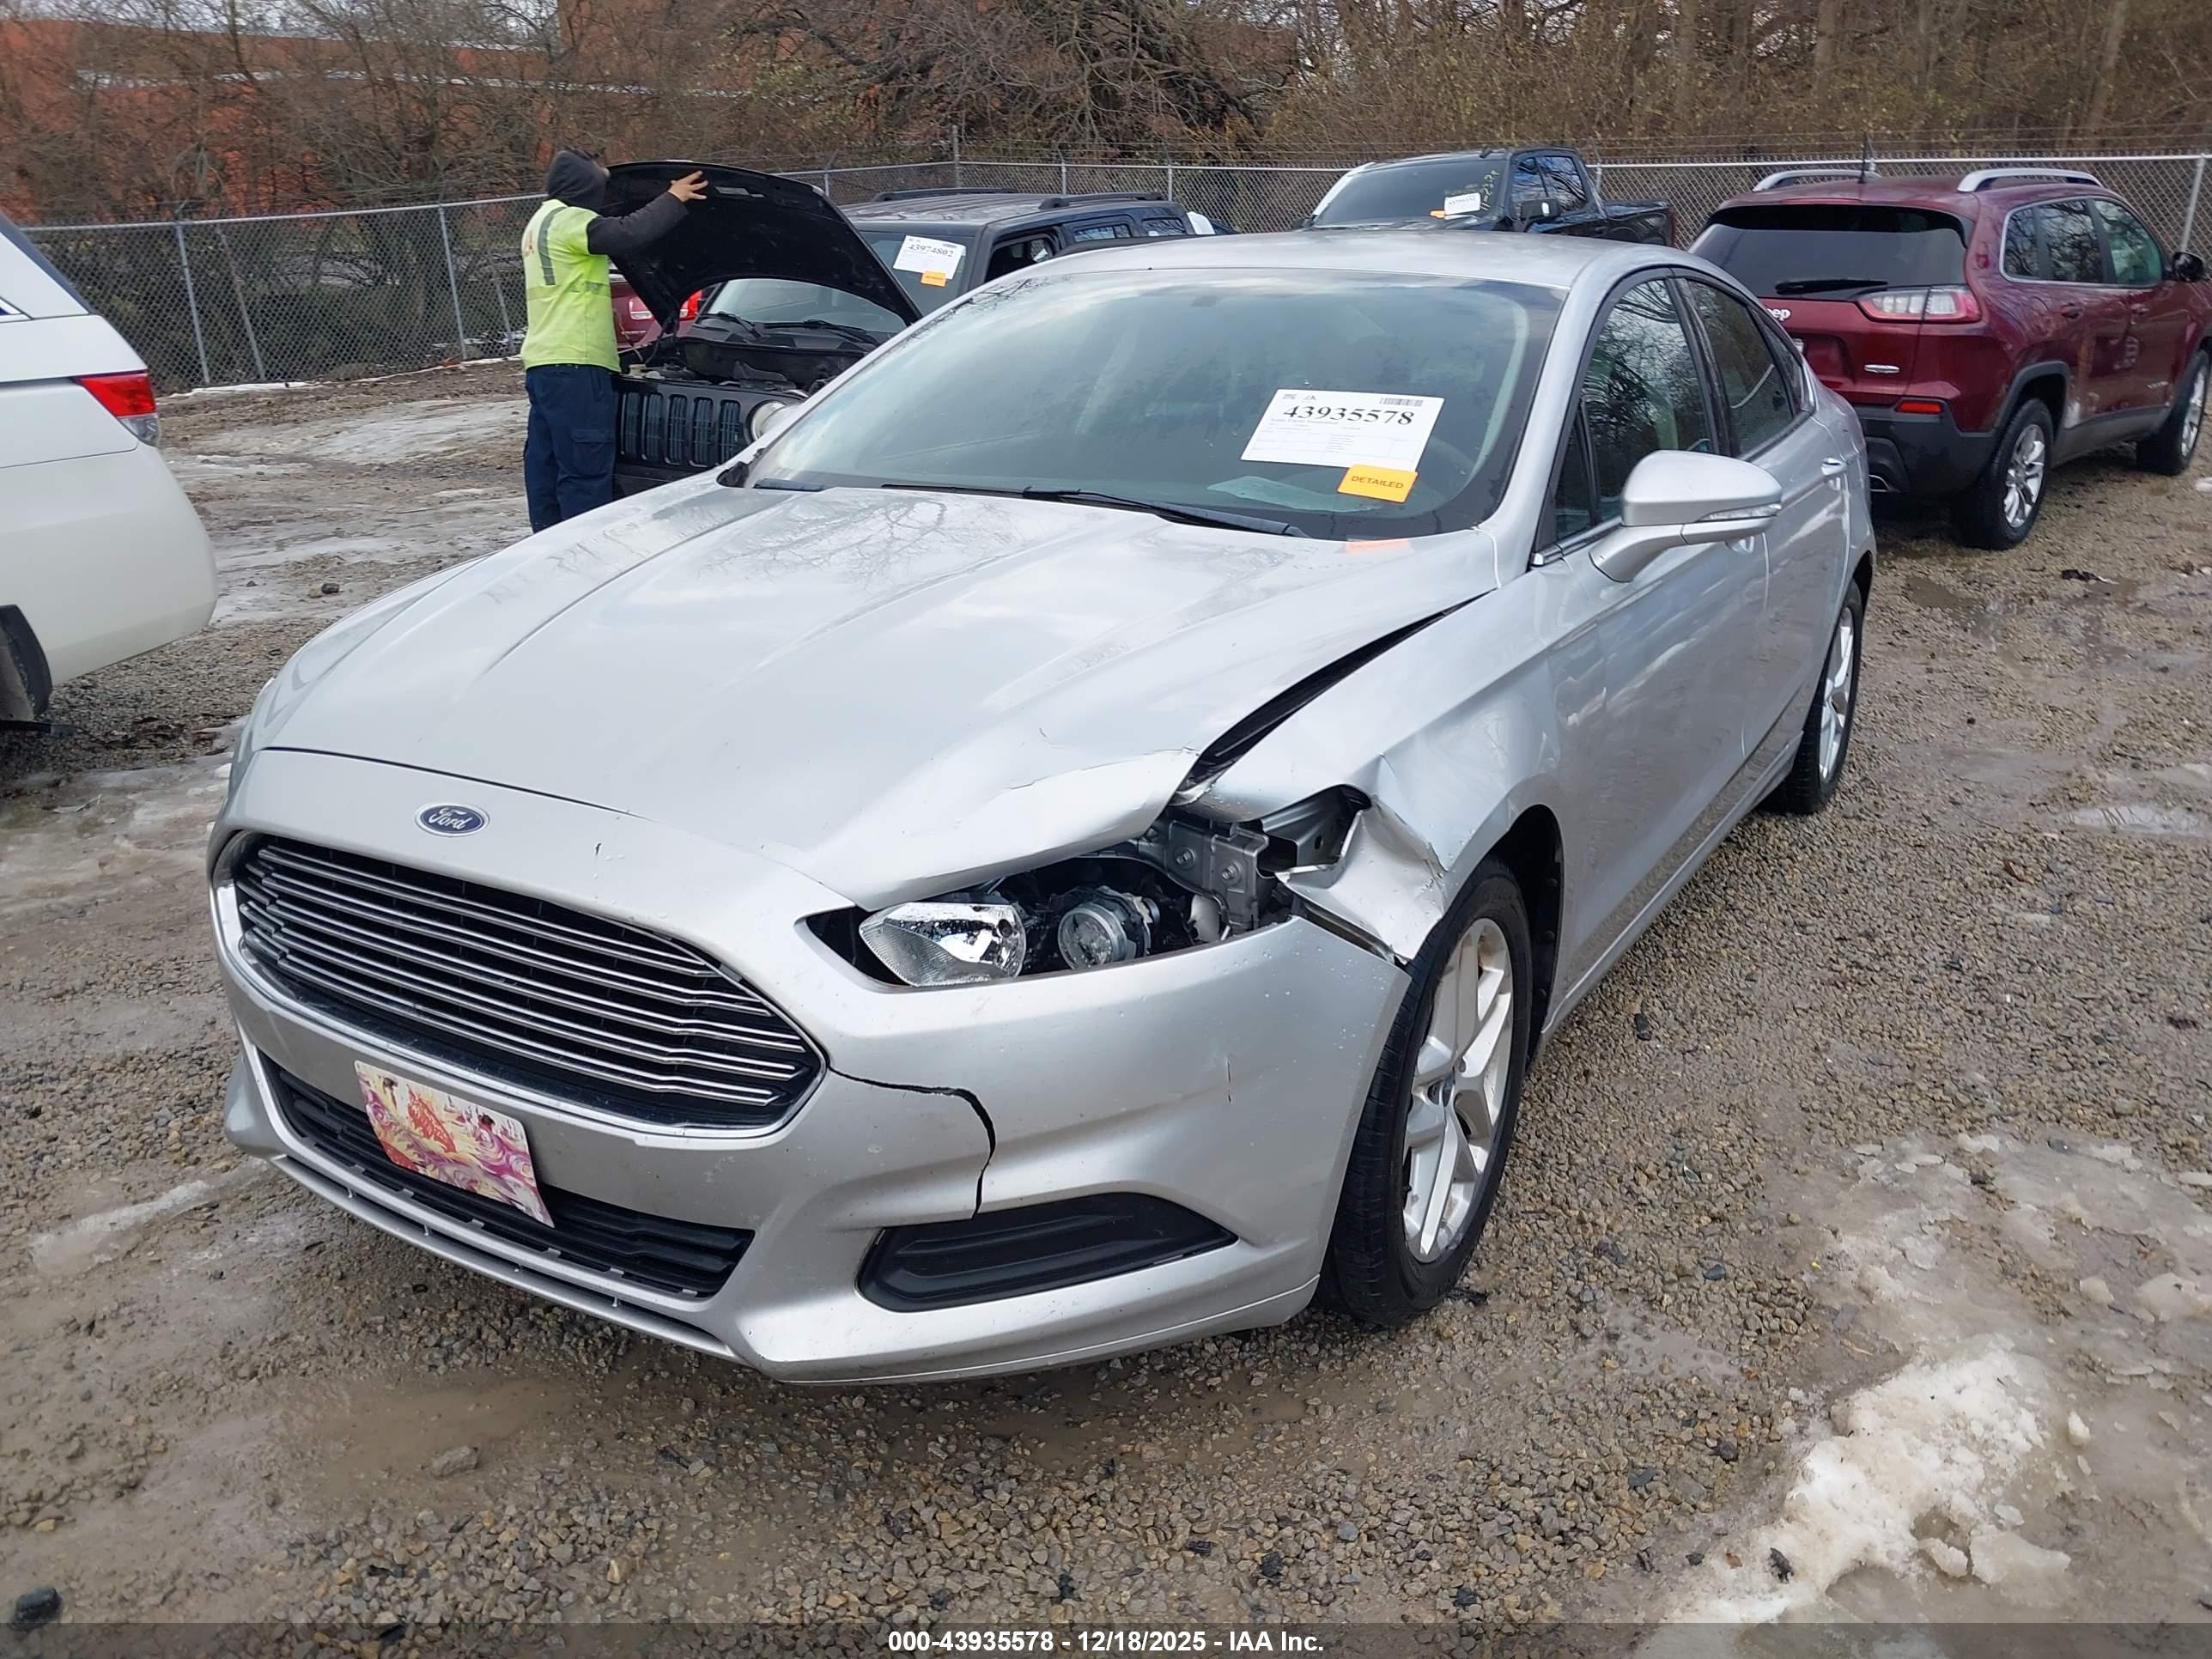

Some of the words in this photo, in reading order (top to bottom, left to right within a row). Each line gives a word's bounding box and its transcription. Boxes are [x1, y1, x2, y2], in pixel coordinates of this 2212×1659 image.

[1766, 308, 1791, 322] ep
[1283, 405, 1415, 426] 43935578
[1351, 475, 1405, 489] DETAILED
[428, 807, 473, 830] Ford
